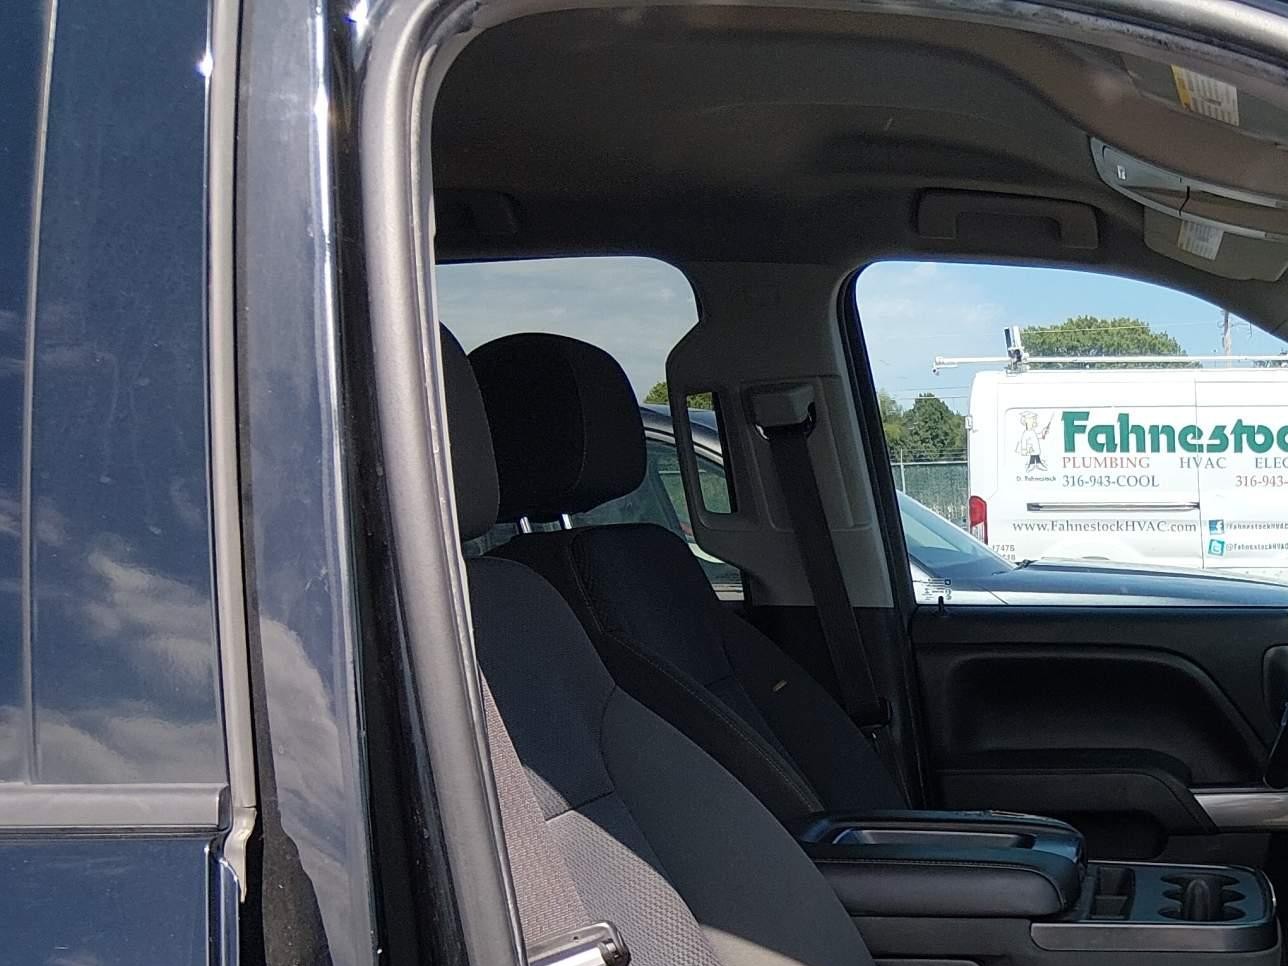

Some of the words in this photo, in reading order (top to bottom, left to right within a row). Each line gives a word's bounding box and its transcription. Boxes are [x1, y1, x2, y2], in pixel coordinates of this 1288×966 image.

[1062, 456, 1150, 469] PLUMBING
[1179, 456, 1227, 469] HVAC
[1062, 475, 1160, 488] 316-943-COOL
[1012, 519, 1197, 533] www.FahnestockHVAC.com
